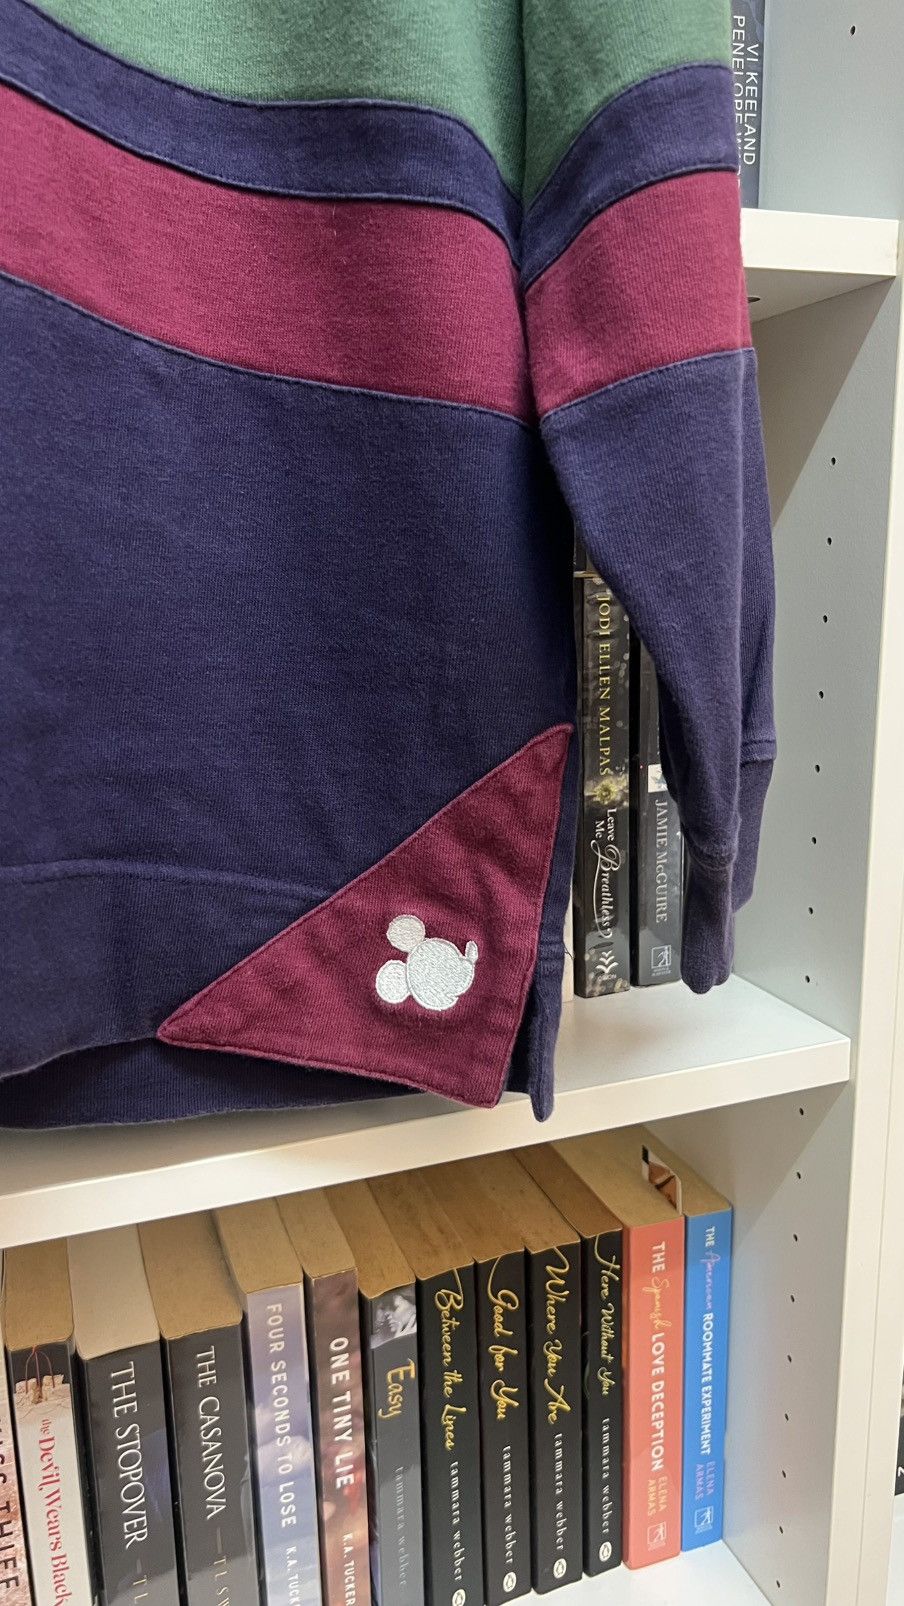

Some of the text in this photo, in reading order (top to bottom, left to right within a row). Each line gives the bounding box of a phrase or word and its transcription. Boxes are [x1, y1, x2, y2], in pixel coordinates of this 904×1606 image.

[743, 44, 759, 165] VI KEELAND
[597, 595, 613, 776] JODI ELLEN MALPAS
[595, 821, 605, 839] Me
[606, 808, 617, 841] Leave
[655, 799, 668, 923] JAMIE McGUIRE
[590, 840, 622, 939] Breathless
[705, 1226, 716, 1248] THE
[434, 1269, 467, 1451] Between the Lines
[487, 1257, 519, 1421] Good for You
[543, 1247, 571, 1424] Where You Are
[594, 1235, 620, 1396] Here Without You
[642, 1241, 672, 1472] THE Spanish LOVE DECEPTION
[701, 1312, 714, 1384] ROOMMATE
[197, 1346, 226, 1520] THE CASANOVA
[267, 1303, 296, 1528] FOUR SECONDS TO LOSE
[330, 1337, 354, 1489] ONE TINY LIE
[378, 1358, 416, 1420] Easy
[700, 1385, 713, 1456] EXPERIMENT
[111, 1361, 149, 1549] THE STOPOVER
[503, 1445, 517, 1564] tammara webber
[554, 1433, 568, 1550] tammara webber
[602, 1418, 612, 1534] tammara webber
[648, 1479, 657, 1517] ARMAS
[658, 1475, 668, 1512] ELENA
[695, 1464, 704, 1501] ARMAS
[706, 1460, 716, 1496] ELENA
[45, 1488, 63, 1551] Wears
[286, 1546, 301, 1606] K.A. TUCK
[343, 1532, 356, 1606] K.A. TUCKER
[450, 1461, 465, 1582] tammara webber
